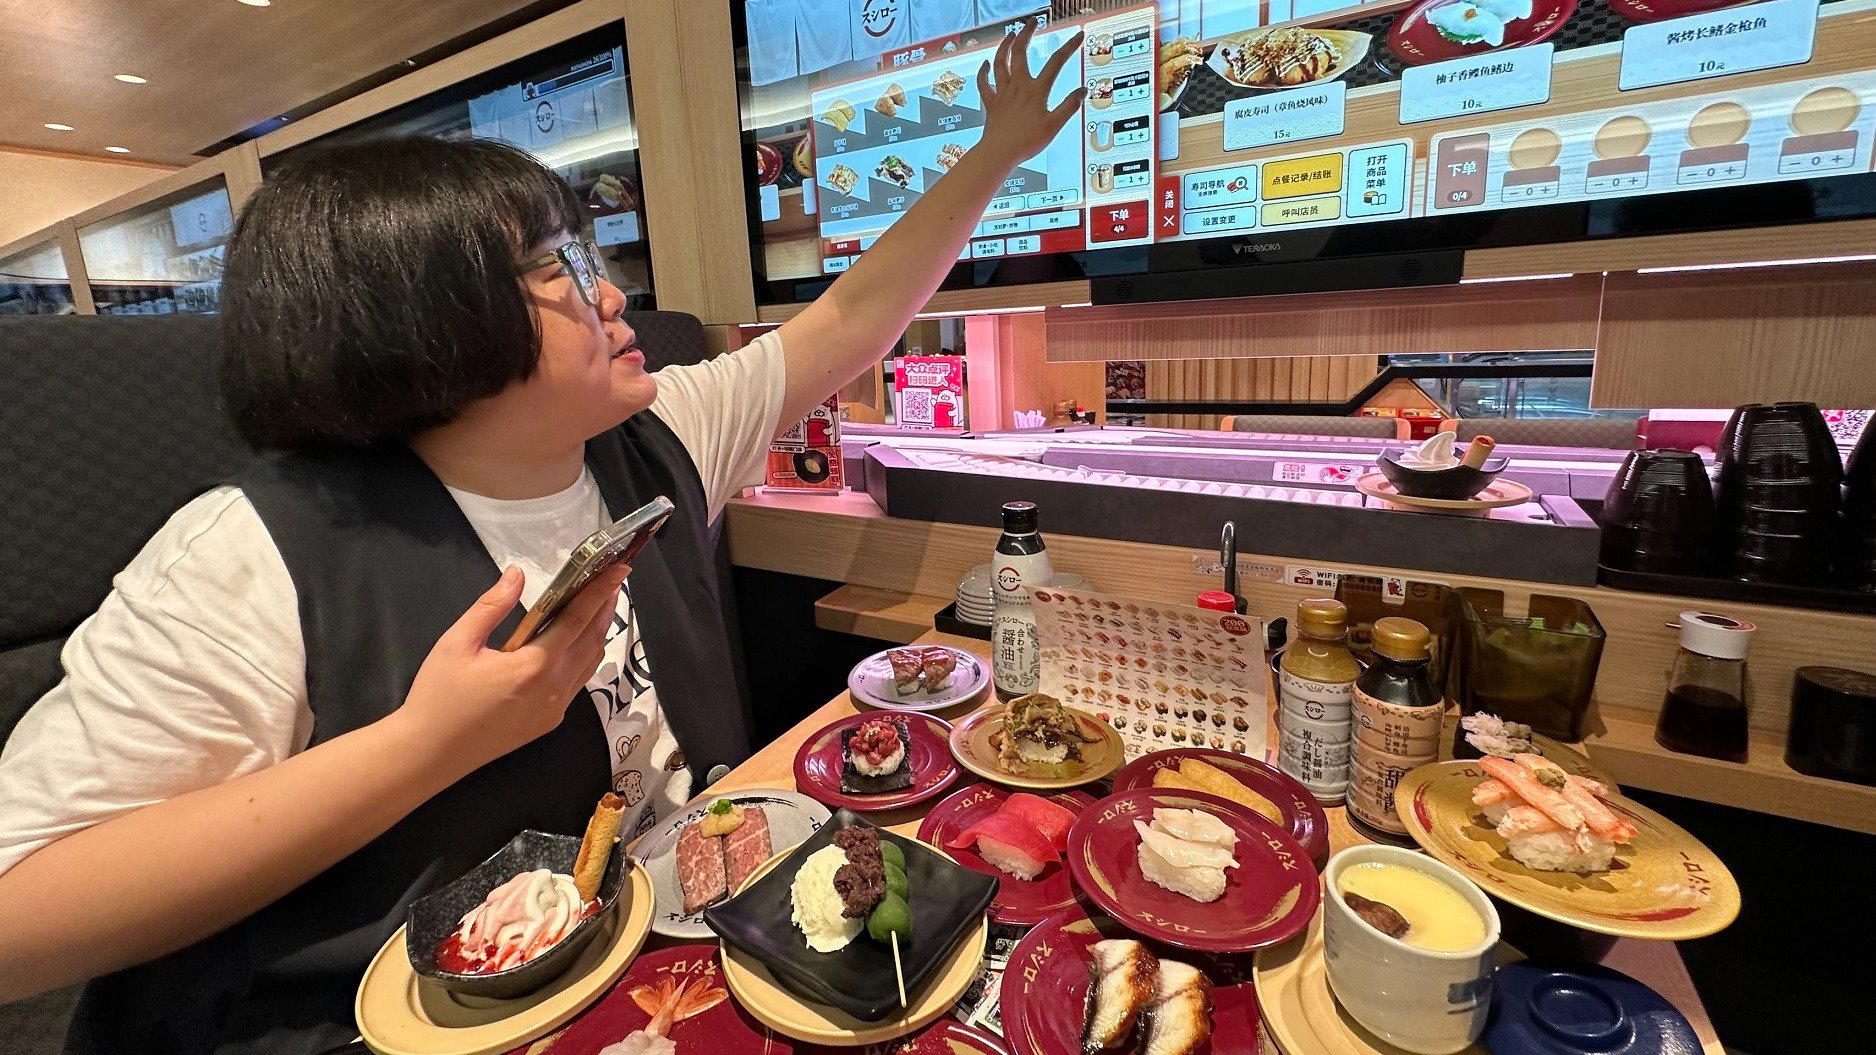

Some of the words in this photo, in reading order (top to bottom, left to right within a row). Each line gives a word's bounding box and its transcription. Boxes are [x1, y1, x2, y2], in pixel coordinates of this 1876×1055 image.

[862, 7, 898, 25] スシロー
[1667, 17, 1767, 45] 酱烤长鳍金枪鱼
[1699, 60, 1725, 73] 10元
[1462, 99, 1482, 110] 10元
[1273, 130, 1291, 140] 15元
[1366, 155, 1388, 166] 打开
[1366, 166, 1387, 177] 商品
[1448, 161, 1477, 178] 下单
[1272, 170, 1332, 186] 点餐记录/结账
[1366, 178, 1386, 189] 菜单
[1191, 180, 1225, 192] 寿司导航
[1453, 190, 1468, 201] 0/4
[1109, 209, 1129, 221] 下单
[1282, 206, 1318, 218] 呼叫店员
[1202, 215, 1236, 226] 设置变更
[1243, 243, 1282, 253] TERAOKA
[906, 363, 949, 374] 大众点评
[997, 575, 1022, 583] スシロー
[1002, 616, 1025, 625] スシロー
[1017, 629, 1026, 653] 合わせ
[1302, 729, 1312, 783] 複合調味料
[1147, 755, 1185, 771] スシロー
[954, 788, 995, 811] スシロー
[1097, 798, 1138, 824] スシロー
[1262, 831, 1299, 870] スシロー
[1679, 851, 1711, 896] スシロー
[1141, 911, 1207, 934] スシロー
[1023, 938, 1054, 994] スシロー
